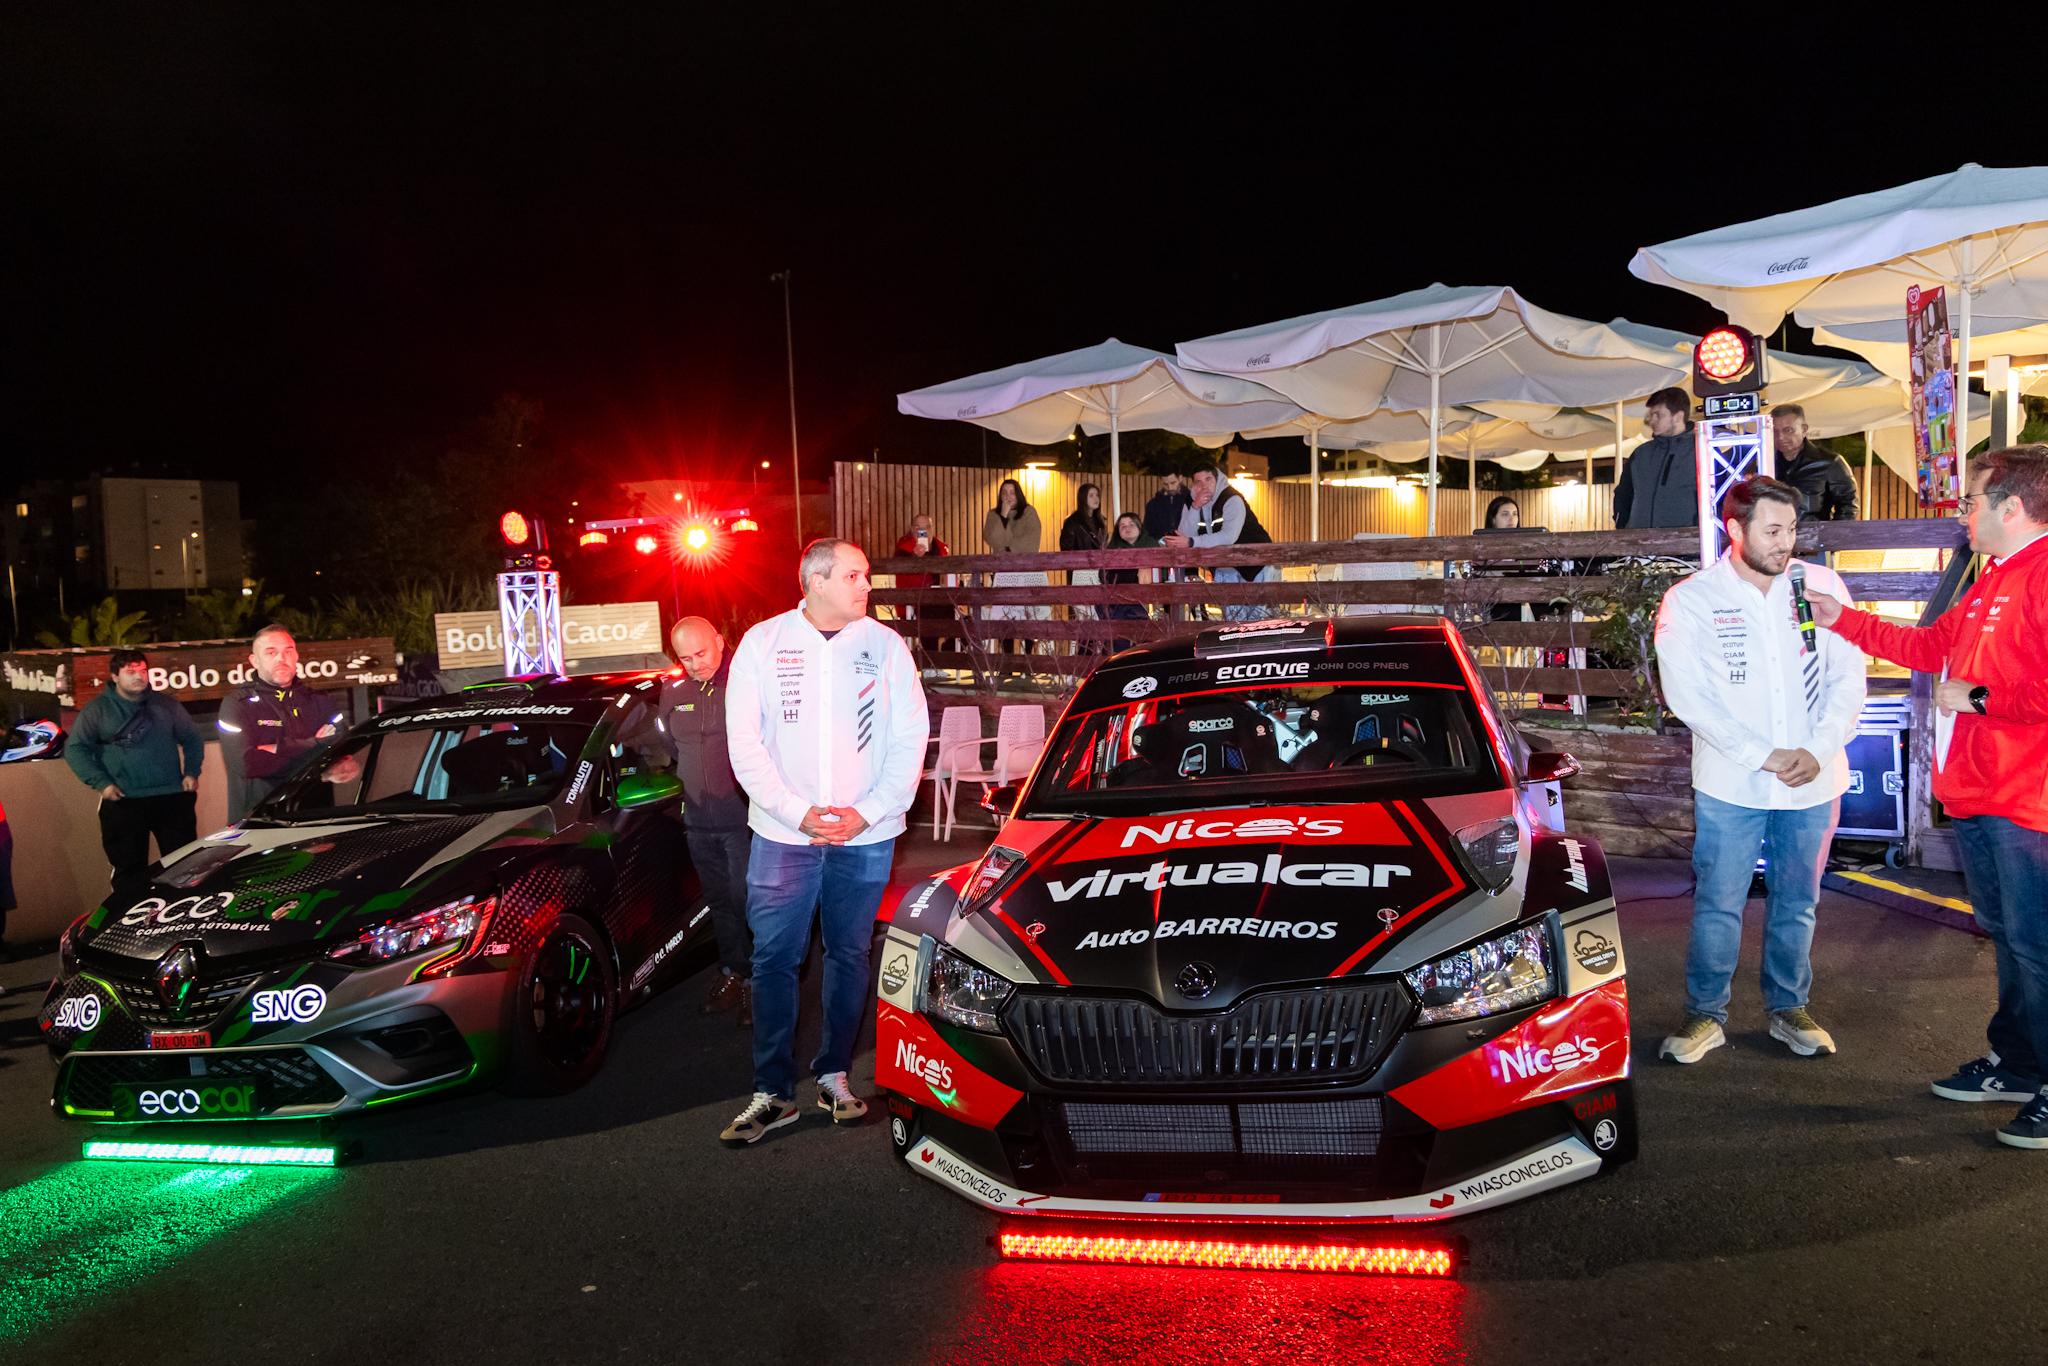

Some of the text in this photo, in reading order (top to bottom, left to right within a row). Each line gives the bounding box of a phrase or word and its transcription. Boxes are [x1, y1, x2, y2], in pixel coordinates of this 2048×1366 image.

[562, 620, 628, 645] Caco
[148, 664, 220, 691] Bolo
[296, 660, 338, 679] aco
[1313, 662, 1344, 671] JOHN
[1347, 662, 1370, 670] DOS
[1373, 662, 1410, 670] PNEUS
[412, 704, 574, 722] ecocar madeira
[565, 760, 590, 805] TOMIAUTO
[1046, 853, 1412, 903] virtualcar
[120, 888, 342, 927] ecocar
[135, 921, 271, 936] COMÉRCIO AUTOMÓVEL
[1075, 917, 1339, 951] Auto BARREIROS
[55, 993, 101, 1031] SNG
[252, 983, 327, 1023] SNG
[139, 1086, 255, 1115] ecocar
[1573, 1091, 1617, 1120] CIAM
[934, 1157, 1008, 1205] MVASCONCELOS
[1460, 1150, 1574, 1201] MVASCONCELOS
